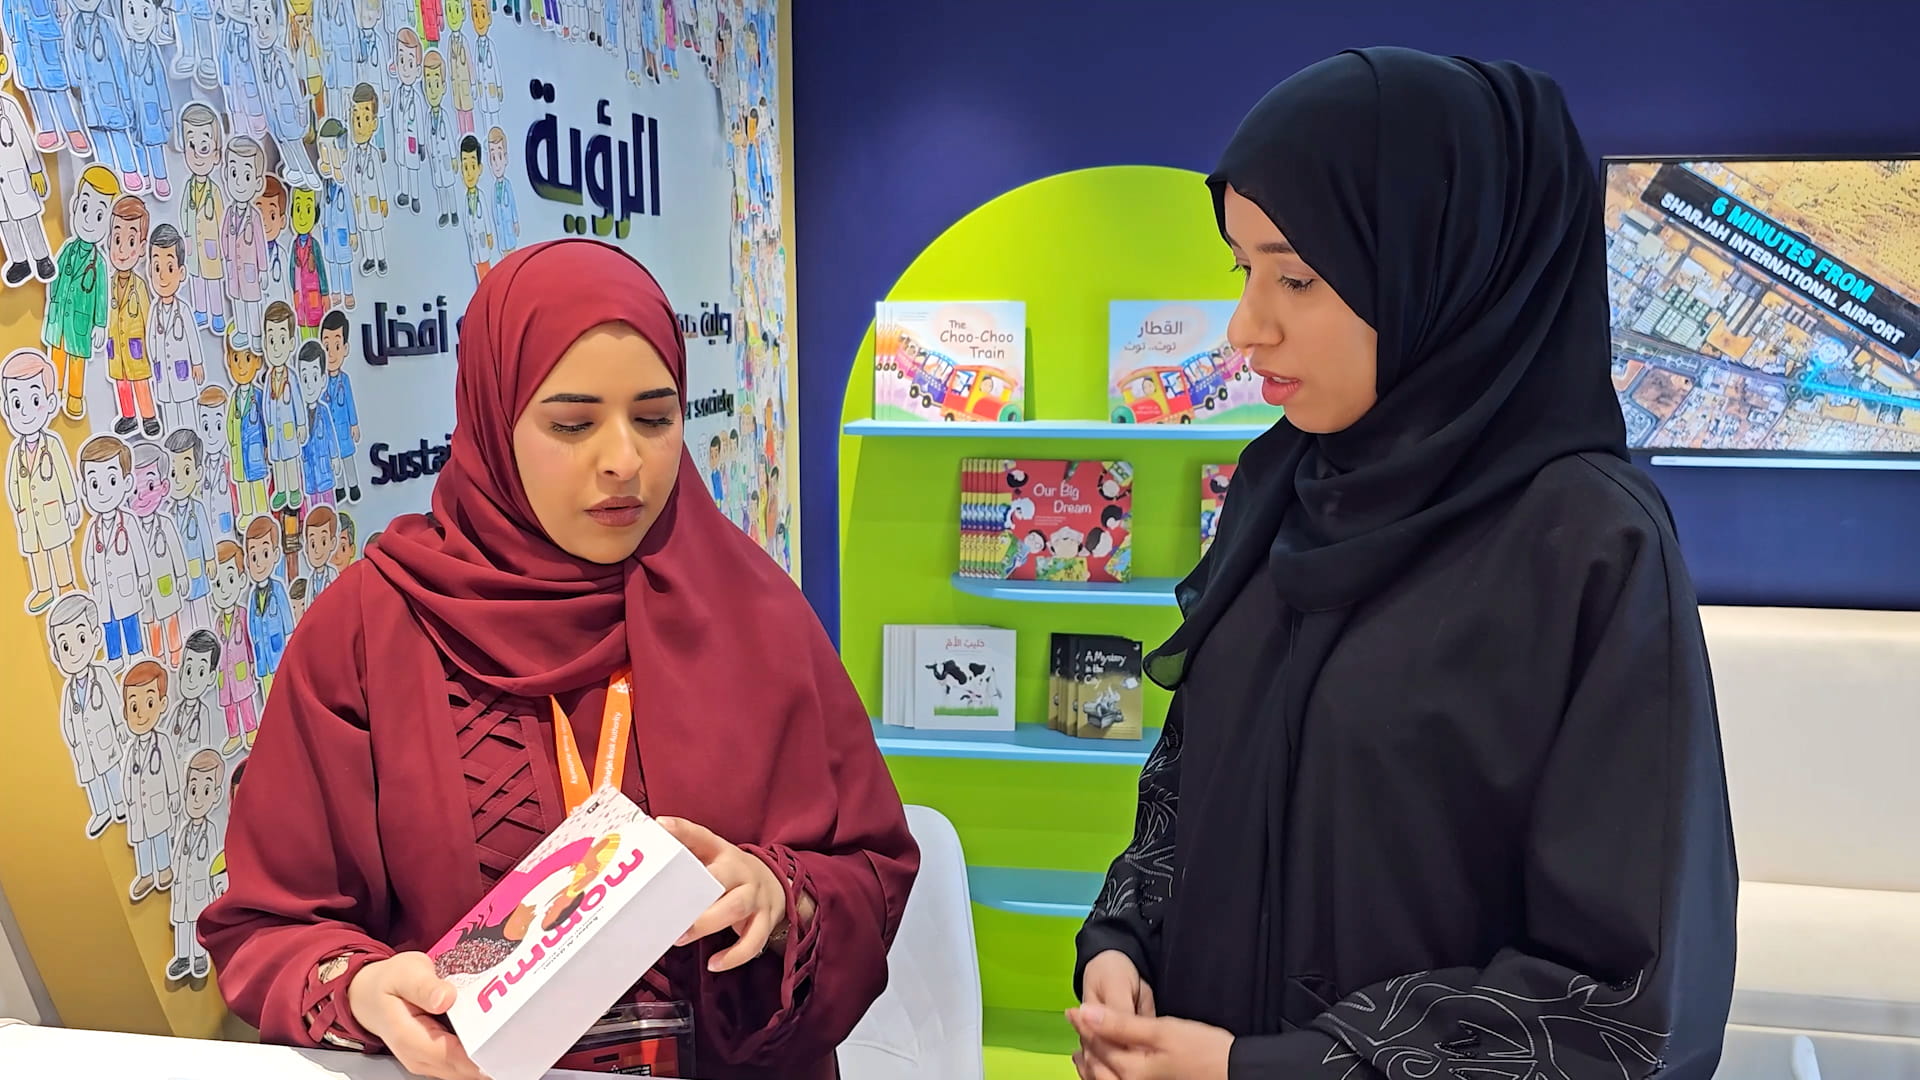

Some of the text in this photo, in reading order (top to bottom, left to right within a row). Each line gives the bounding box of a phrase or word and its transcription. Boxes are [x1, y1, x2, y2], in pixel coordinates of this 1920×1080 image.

[525, 79, 661, 239] الرؤية
[1711, 197, 1875, 303] 6 MINUTES FROM
[1660, 192, 1905, 345] SHARJAH INTERNATIONAL AIRPORT
[361, 296, 450, 366] أفضل
[949, 319, 967, 330] The
[1137, 320, 1183, 338] القطار
[940, 330, 1015, 343] Choo-Choo
[969, 346, 1005, 359] Train
[694, 389, 735, 417] society
[1033, 480, 1079, 501] Our Big
[1053, 500, 1092, 514] Dream
[1085, 650, 1093, 662] A
[477, 848, 645, 1013] mommy
